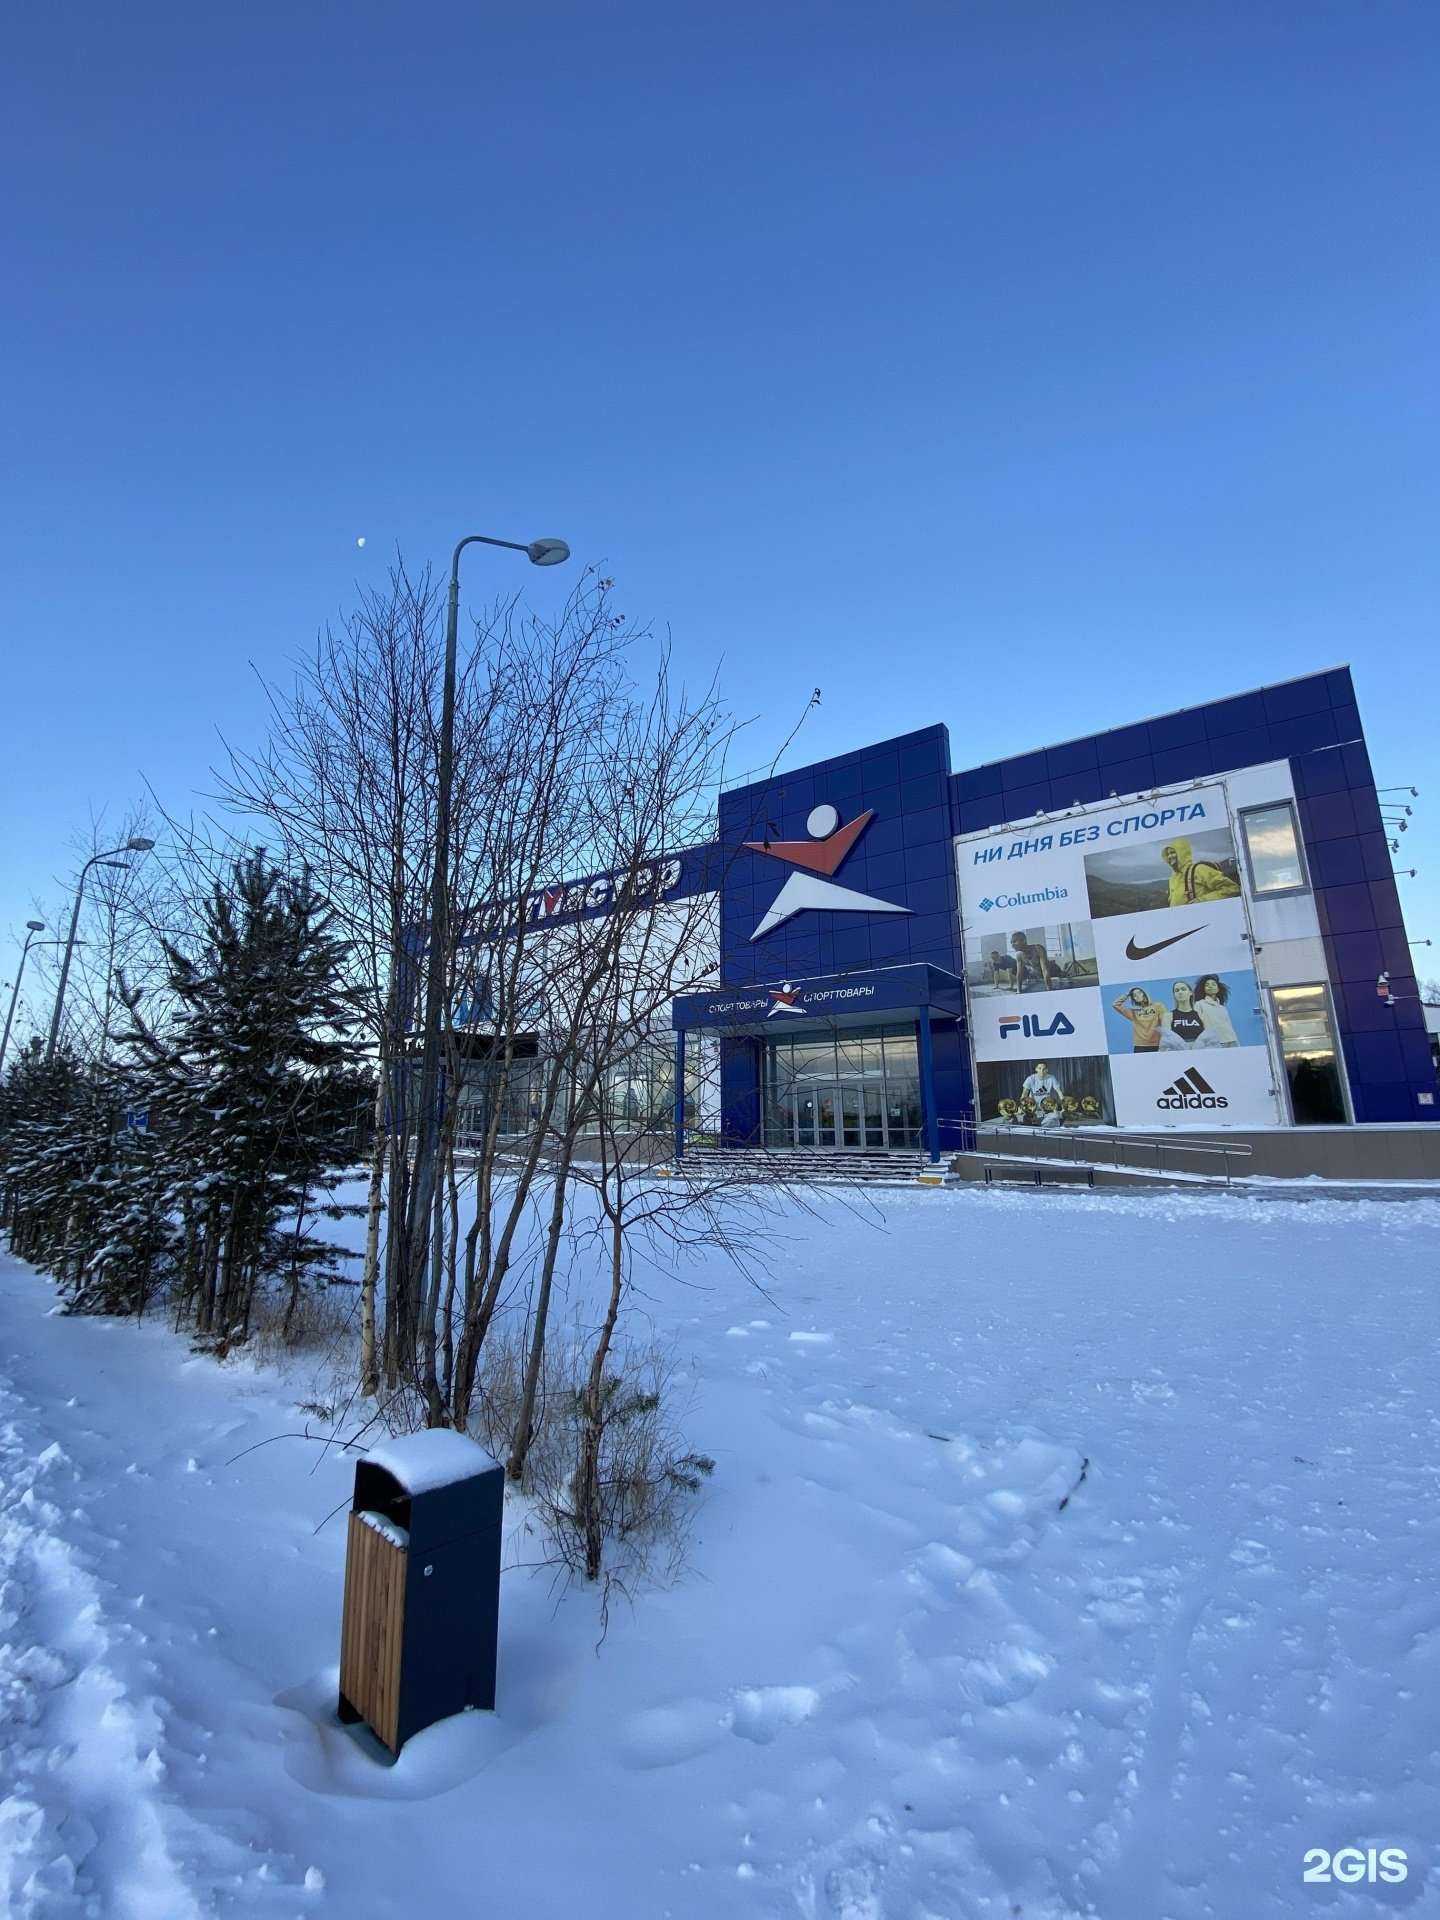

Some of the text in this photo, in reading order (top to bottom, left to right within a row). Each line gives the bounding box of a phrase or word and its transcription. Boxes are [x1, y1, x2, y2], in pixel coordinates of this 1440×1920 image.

[973, 802, 1206, 865] НИ ДНЯ БЕЗ СПОРТА
[995, 886, 1068, 909] Columbia
[803, 986, 875, 1003] СПОРТТОВАРЫ
[998, 1011, 1075, 1040] FILA
[1174, 1019, 1200, 1027] FILA
[1157, 1094, 1229, 1109] adidas
